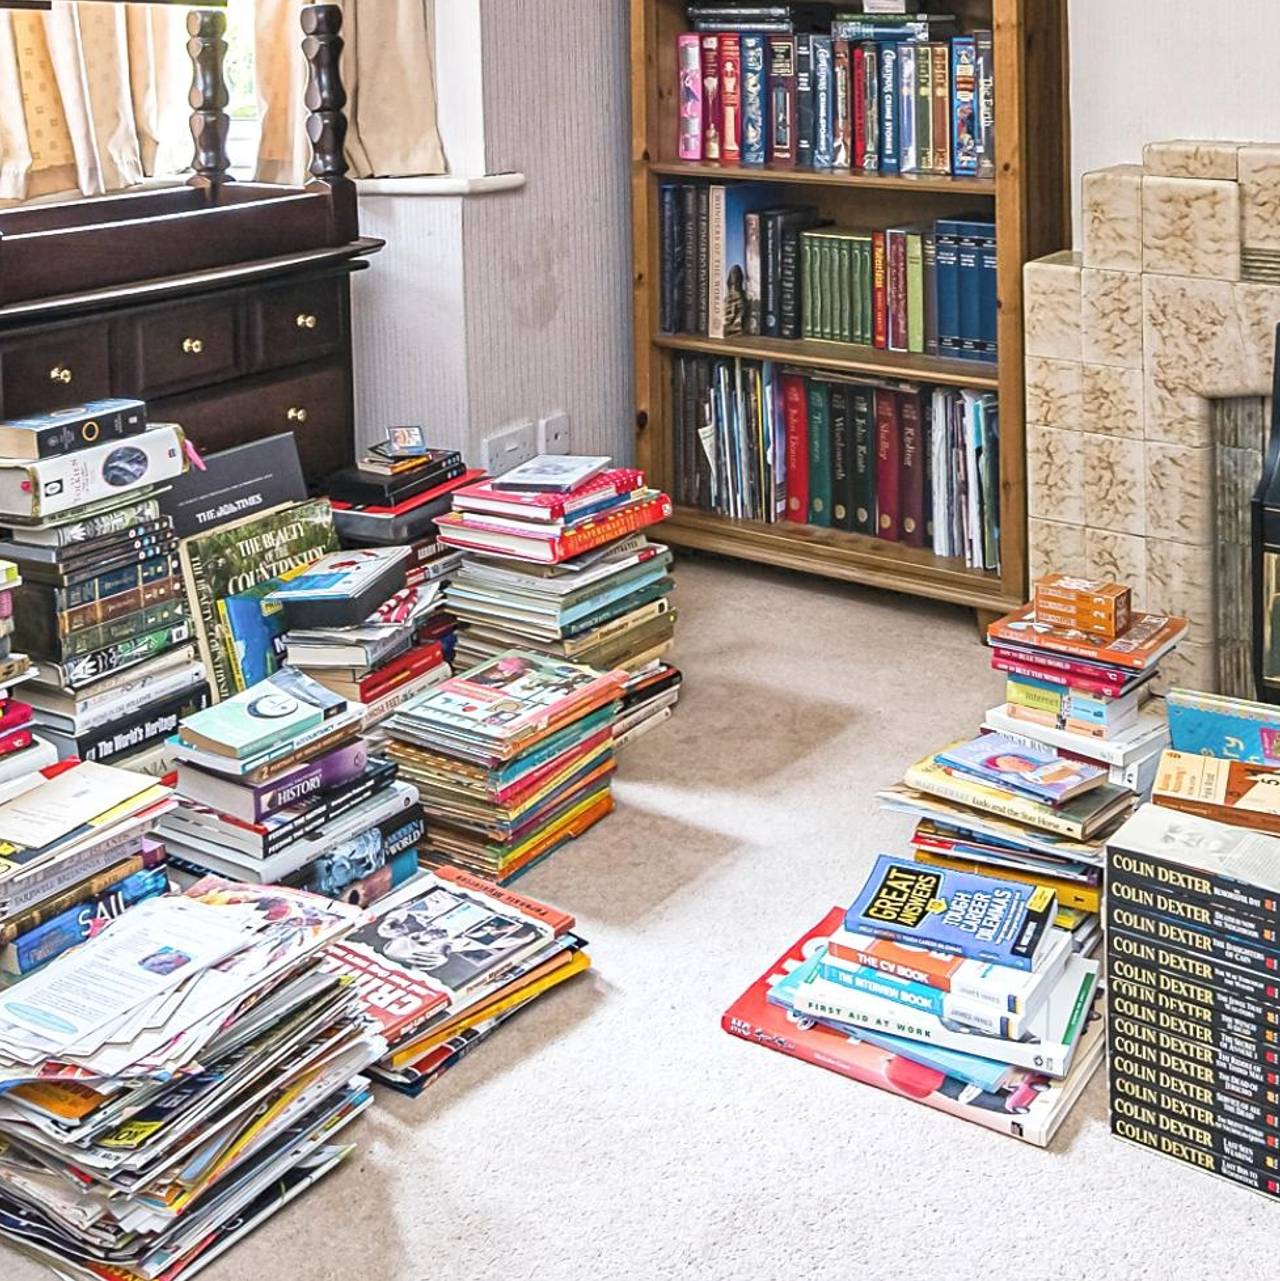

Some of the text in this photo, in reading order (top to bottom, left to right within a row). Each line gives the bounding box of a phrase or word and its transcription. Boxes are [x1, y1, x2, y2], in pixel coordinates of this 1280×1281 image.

[884, 94, 892, 120] CRIME
[983, 99, 994, 128] Earth
[884, 121, 893, 155] STORIES
[879, 419, 889, 462] Shelley
[903, 425, 915, 468] Kipling
[195, 493, 264, 524] THE TIMES
[236, 521, 306, 558] THE BEAUTY
[1093, 597, 1105, 606] 3
[1093, 610, 1106, 619] 2
[96, 714, 180, 758] The World's Heritage
[277, 774, 323, 806] HISTORY
[991, 802, 1021, 817] and the
[387, 828, 424, 855] WORLD
[869, 869, 908, 921] GREAT
[1113, 854, 1211, 895] COLIN DEXTER
[902, 874, 937, 927] ANSWERS
[945, 890, 972, 927] TOUGH
[959, 892, 991, 934] CAREER
[976, 887, 1012, 945] DILEMMAS
[1111, 882, 1211, 924] COLIN DEXTER
[1113, 909, 1212, 952] COLIN DEXTER
[856, 952, 931, 984] THE CV BOOK
[1113, 936, 1212, 979] COLIN DEXTER
[900, 989, 935, 1010] BOOK
[1113, 980, 1212, 1022] COLIN DEXTER
[1114, 961, 1214, 1005] COLIN DEXTER
[807, 998, 933, 1040] FIRST AID AT WORK
[1114, 997, 1212, 1042] COLIN DEXTER
[1114, 1018, 1213, 1063] COLIN DEXTER
[1114, 1038, 1214, 1084] COLIN DEXTER
[1114, 1057, 1213, 1104] COLIN DEXTER
[1116, 1078, 1214, 1125] COLIN DEXTER
[1114, 1099, 1213, 1147] COLIN DEXTER
[1116, 1120, 1215, 1170] COLIN DEXTER
